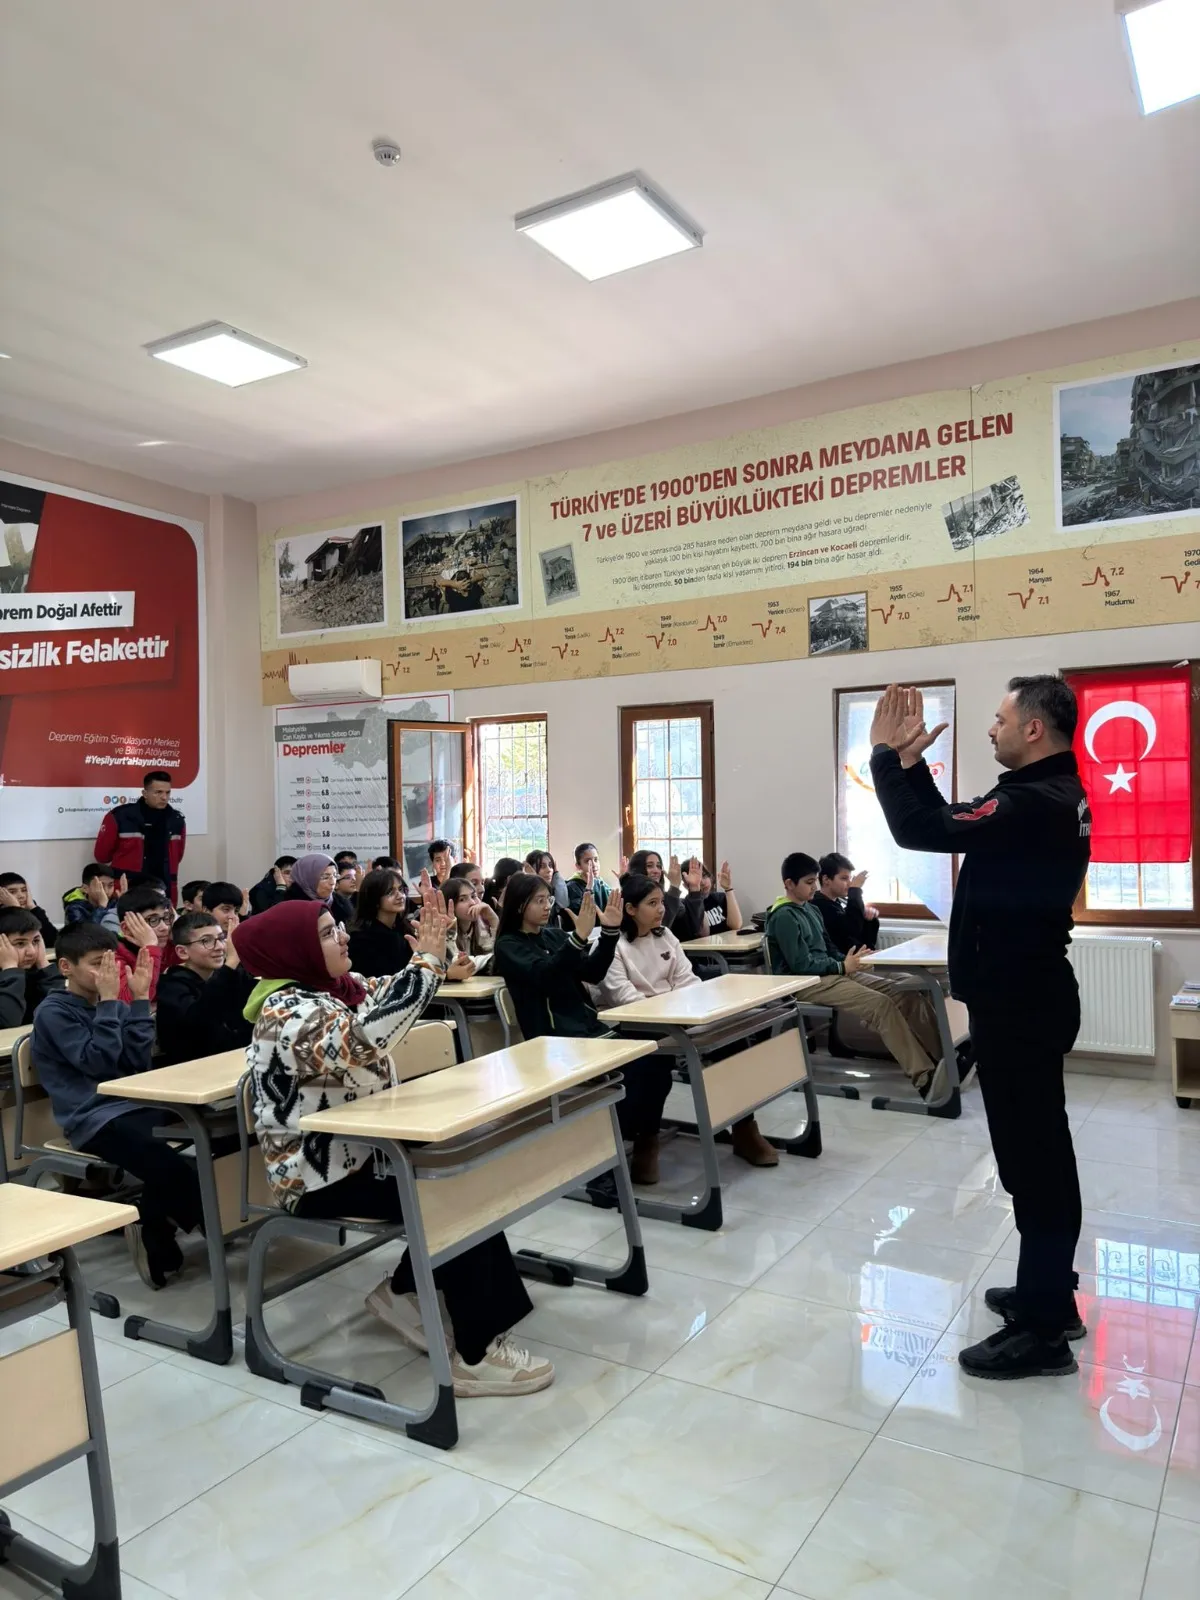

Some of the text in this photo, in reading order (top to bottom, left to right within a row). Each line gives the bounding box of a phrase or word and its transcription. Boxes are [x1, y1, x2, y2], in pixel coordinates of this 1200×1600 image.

[550, 412, 1013, 520] TÜRKİYE'DE 1900'DEN SONRA MEYDANA GELEN
[582, 454, 966, 542] 7 ve ÜZERİ BÜYÜKLÜKTEKİ DEPREMLER
[683, 541, 695, 551] 285
[782, 522, 812, 534] meydana
[833, 517, 842, 525] ve
[843, 514, 853, 523] bu
[855, 508, 893, 522] depremler
[894, 502, 933, 515] nedeniyle
[682, 552, 693, 560] bin
[760, 538, 773, 548] 700
[774, 536, 785, 545] bin
[787, 533, 802, 543] bina
[803, 531, 817, 542] ağır
[819, 528, 841, 539] hasara
[722, 561, 730, 570] en
[762, 553, 788, 565] deprem
[788, 548, 819, 559] Erzincan
[820, 546, 829, 554] ve
[830, 540, 858, 553] Kocaeli
[859, 533, 912, 548] depremleridir.
[674, 577, 683, 586] 50
[787, 560, 799, 569] 194
[801, 558, 813, 567] bin
[814, 556, 829, 566] bina
[830, 554, 844, 564] ağır
[846, 550, 866, 560] hasar
[1028, 567, 1044, 575] 1964
[1110, 566, 1125, 576] 7.2
[1028, 575, 1053, 585] Manyas
[962, 583, 973, 593] 7.1
[1104, 590, 1121, 598] 1967
[1037, 596, 1049, 605] 7.1
[36, 603, 77, 621] Doğal
[80, 602, 123, 617] Afettir
[957, 605, 971, 613] 1957
[717, 615, 728, 623] 7.0
[898, 611, 910, 620] 7.0
[957, 613, 980, 622] Fethiye
[615, 627, 625, 635] 7.2
[775, 626, 786, 634] 7.4
[667, 638, 677, 647] 7.0
[0, 635, 169, 670] sizlik Felakettir
[570, 649, 579, 657] 7.2
[48, 731, 180, 748] Deprem Eğitim Simülasyon Merkezi
[114, 746, 180, 758] ve Bilim Atölyemiz
[282, 741, 346, 758] Depremler
